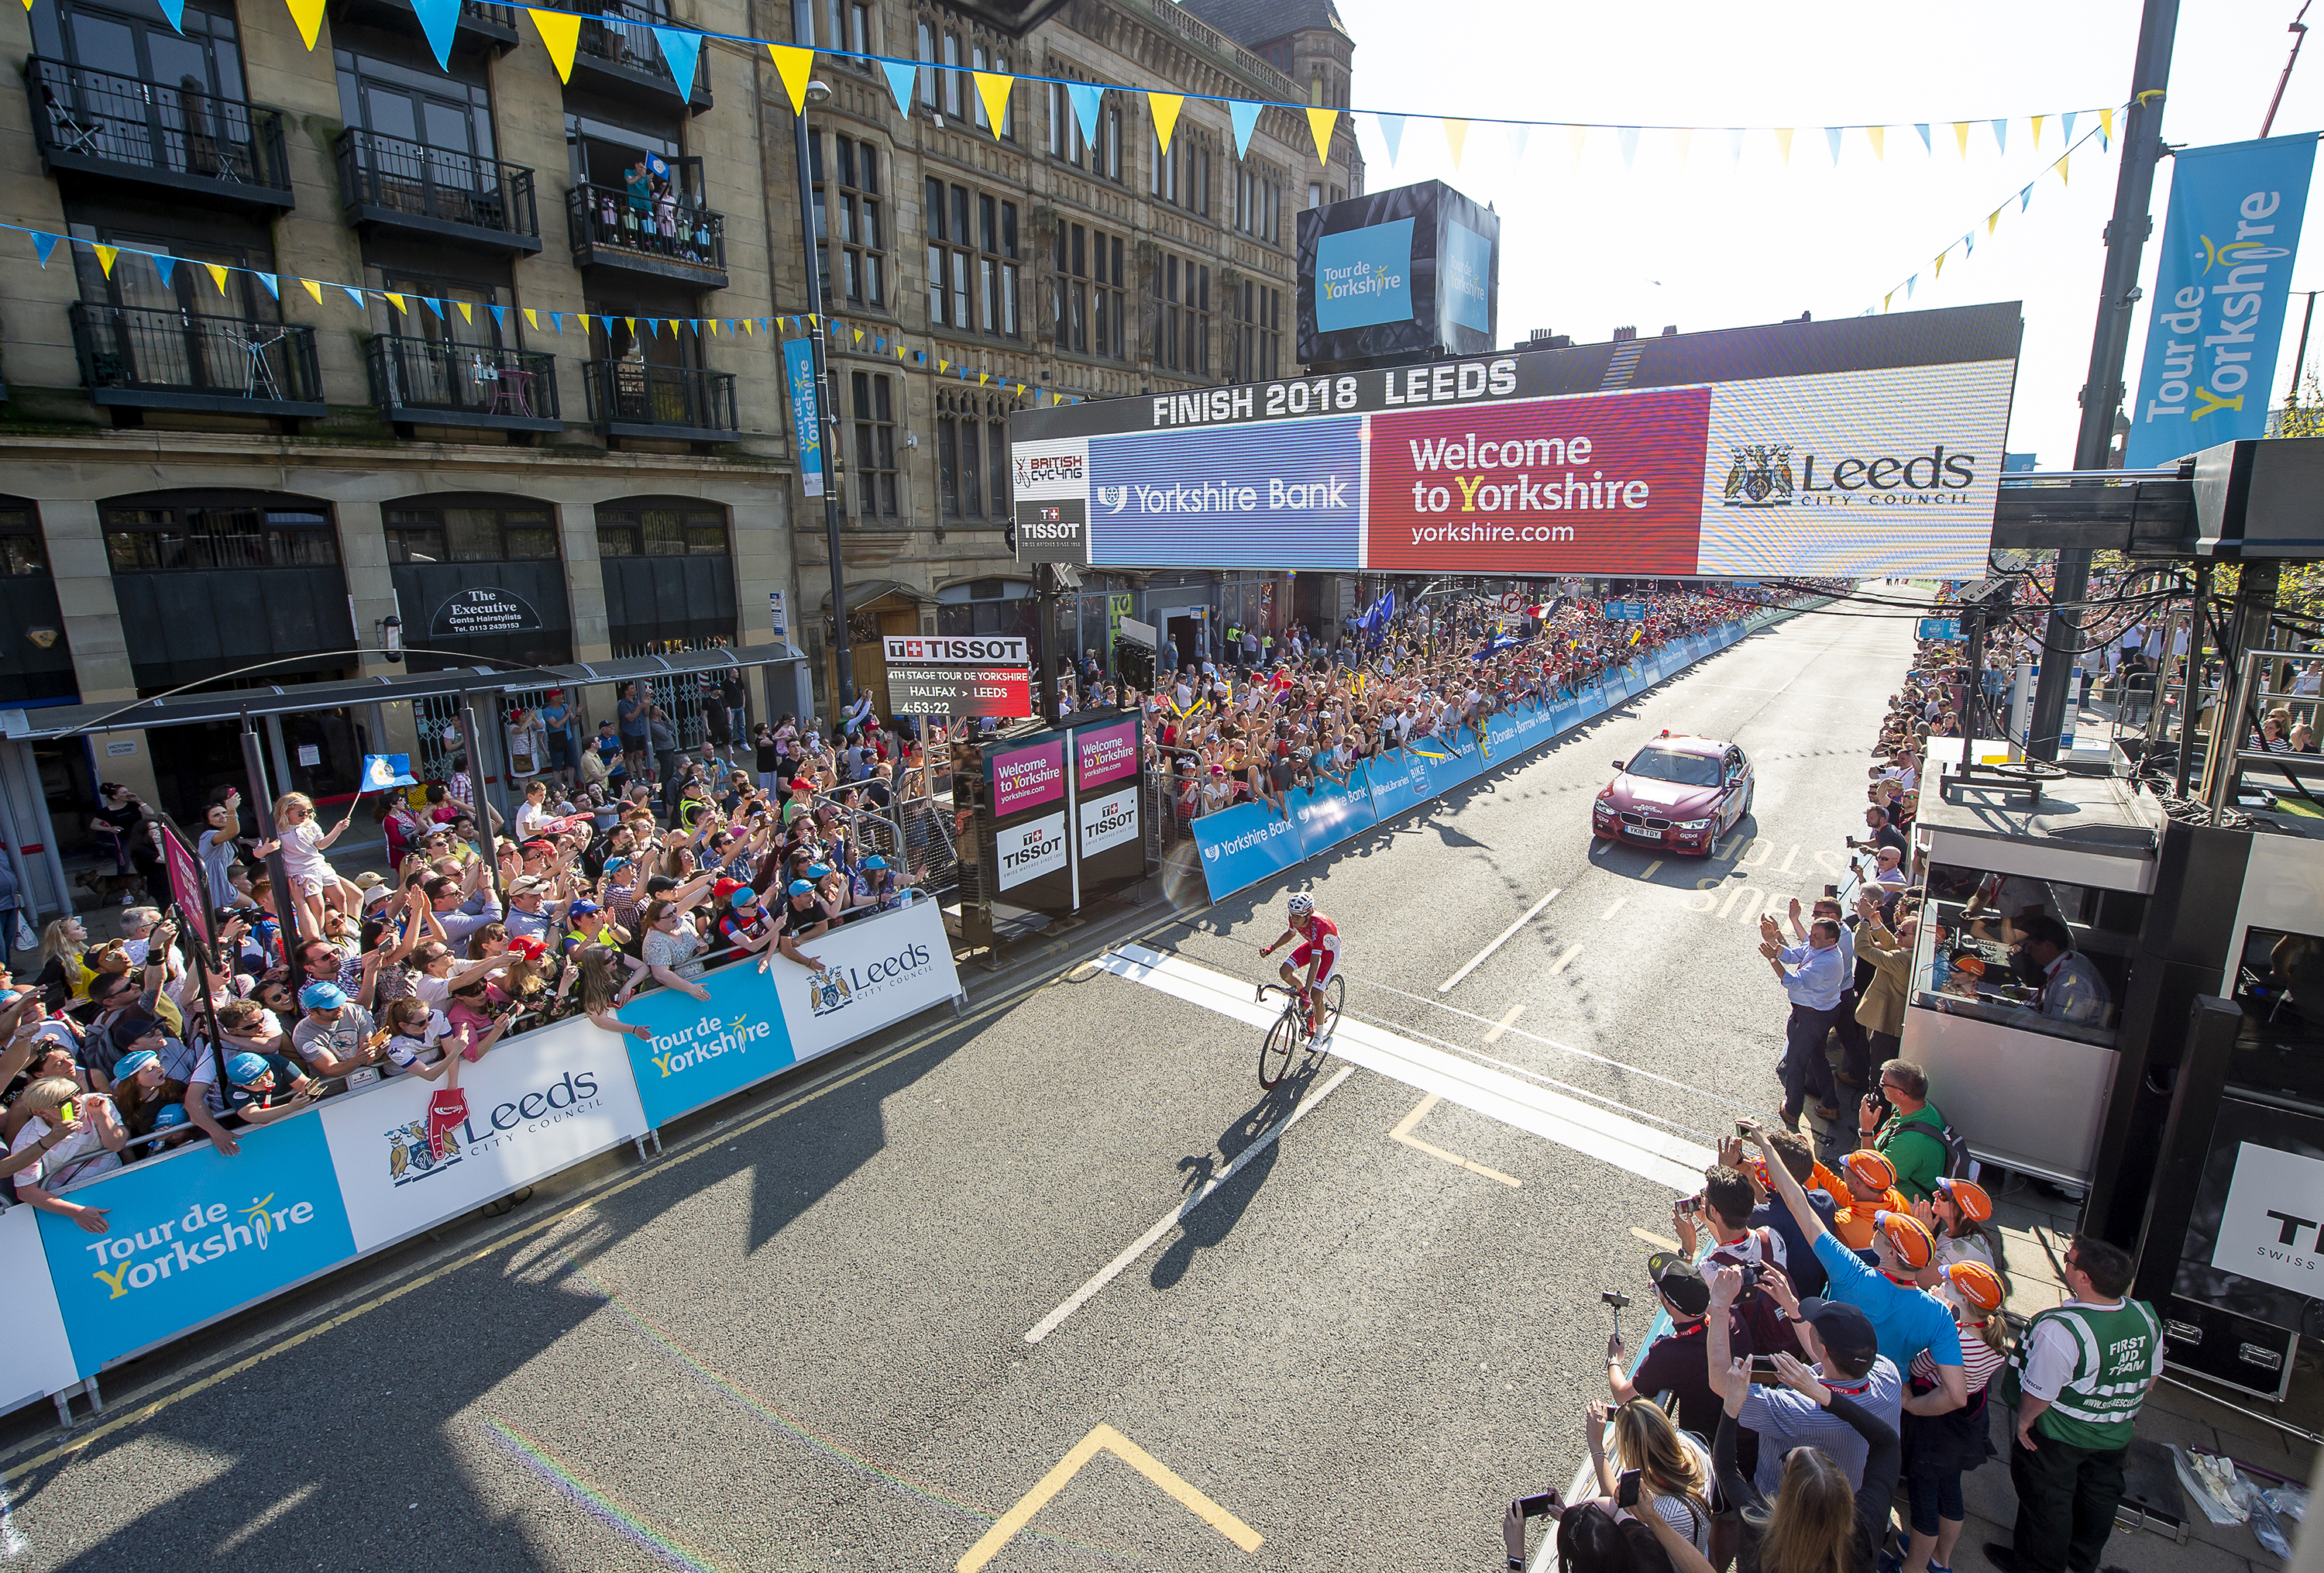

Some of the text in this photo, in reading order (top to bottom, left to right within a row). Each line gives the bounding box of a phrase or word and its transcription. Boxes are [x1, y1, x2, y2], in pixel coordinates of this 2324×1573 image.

[1324, 261, 1370, 281] Tour de
[1450, 254, 1472, 278] Tour de
[1324, 265, 1401, 299] Yorkshire
[1450, 270, 1485, 303] Yorkshire
[2191, 191, 2291, 422] Yorkshire
[2145, 286, 2205, 423] Tour de
[1153, 359, 1517, 426] FINISH 2018 LEEDS
[796, 360, 821, 453] Yorkshire
[794, 398, 806, 454] Tour de
[1030, 456, 1082, 470] BRITISH
[1409, 433, 1592, 472] Welcome
[1803, 446, 1975, 491] Leeds
[1134, 474, 1349, 514] Yorkshire Bank
[1411, 470, 1649, 512] to Yorkshire
[1801, 494, 1971, 506] CITY COUNCIL
[1021, 523, 1080, 539] TISSOT
[1411, 521, 1575, 546] yorkshire.com
[468, 590, 497, 602] The
[1112, 596, 1129, 612] TO
[451, 602, 517, 615] Executive
[476, 614, 522, 623] Hairstylists
[489, 622, 520, 631] 2439153
[925, 640, 1023, 659] TISSOT
[888, 671, 1028, 682] 4TH STAGE TOUR DE YORKSHIRE
[909, 686, 957, 697] HALIFAX
[974, 687, 1008, 698] LEEDS
[901, 701, 951, 714] 4:53:22
[1491, 710, 1550, 745] Donate Borrow Ride
[1082, 737, 1123, 756] Welcome
[1084, 746, 1134, 769] to Yorkshire
[1462, 741, 1476, 756] Bank
[998, 758, 1047, 780] Welcome
[1000, 767, 1061, 793] to Yorkshire
[1084, 762, 1122, 780] yorkshire.com
[1410, 765, 1425, 780] BIKE
[1001, 785, 1045, 804] yorkshire.com
[1372, 776, 1410, 797] @BikeLibraries
[1309, 786, 1368, 819] Yorkshire Bank
[1085, 810, 1135, 838] TISSOT
[1630, 826, 1659, 838] YK18 TDY
[1085, 838, 1098, 847] SWISS
[1098, 832, 1115, 842] WATCHES
[1220, 818, 1294, 857] Yorkshire Bank
[1002, 836, 1062, 869] TISSOT
[1004, 869, 1018, 879] SWISS
[1019, 861, 1039, 873] WATCHES
[1040, 856, 1053, 865] SINCE
[850, 943, 930, 991] Leeds
[857, 965, 933, 1000] CITY COUNCIL
[646, 1017, 722, 1055] Tour de
[651, 1014, 770, 1078] Yorkshire
[464, 1072, 598, 1144] Leeds
[471, 1099, 603, 1156] CITY COUNCIL
[1856, 1164, 1879, 1184] HOLDSWORTH
[1964, 1194, 1981, 1217] HOLDSWORTH
[86, 1203, 229, 1266] Tour de
[93, 1192, 315, 1300] Yorkshire
[1893, 1230, 1910, 1258] HOLDSWORTH
[2257, 1246, 2315, 1270] SWISS
[1961, 1277, 1985, 1303] HOLDSWORTH
[2109, 1335, 2147, 1356] FIRST
[2118, 1350, 2140, 1365] AID
[2108, 1359, 2146, 1376] TEAM
